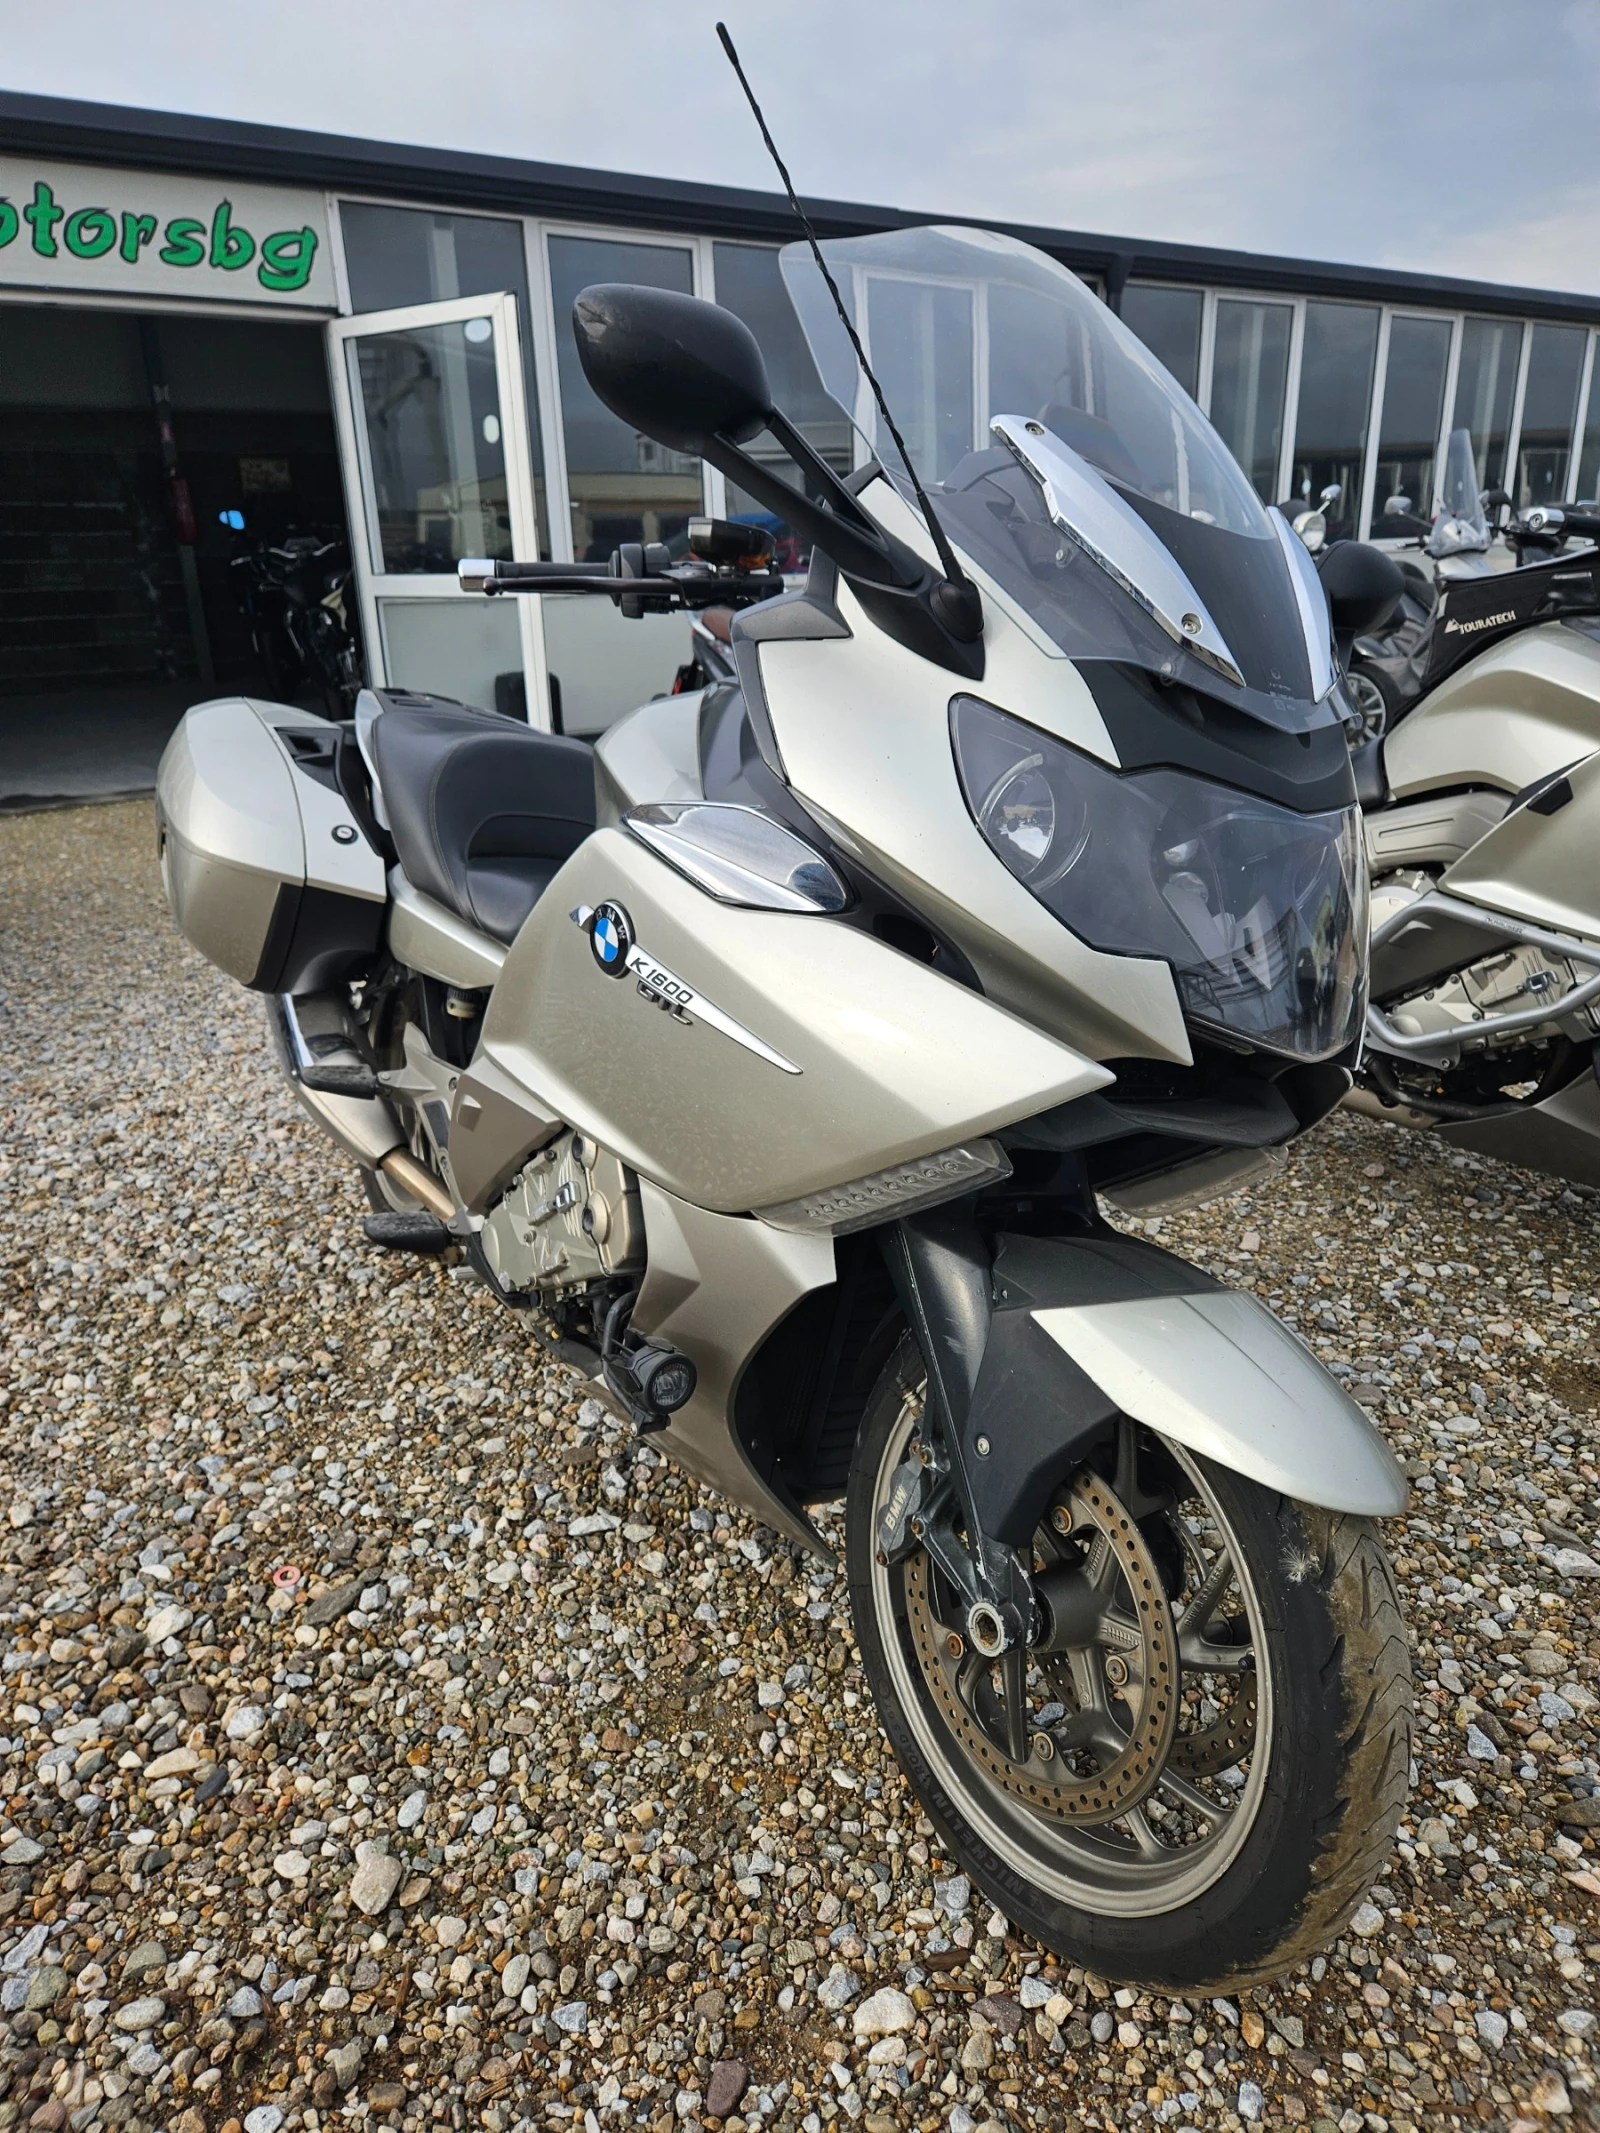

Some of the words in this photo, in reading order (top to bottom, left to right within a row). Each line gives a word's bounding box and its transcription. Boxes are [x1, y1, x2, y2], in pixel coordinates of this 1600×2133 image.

[1459, 610, 1517, 635] TOURATECH
[596, 908, 627, 940] BMW
[885, 1484, 907, 1531] BMW
[932, 1791, 1024, 1895] MICHELIN
